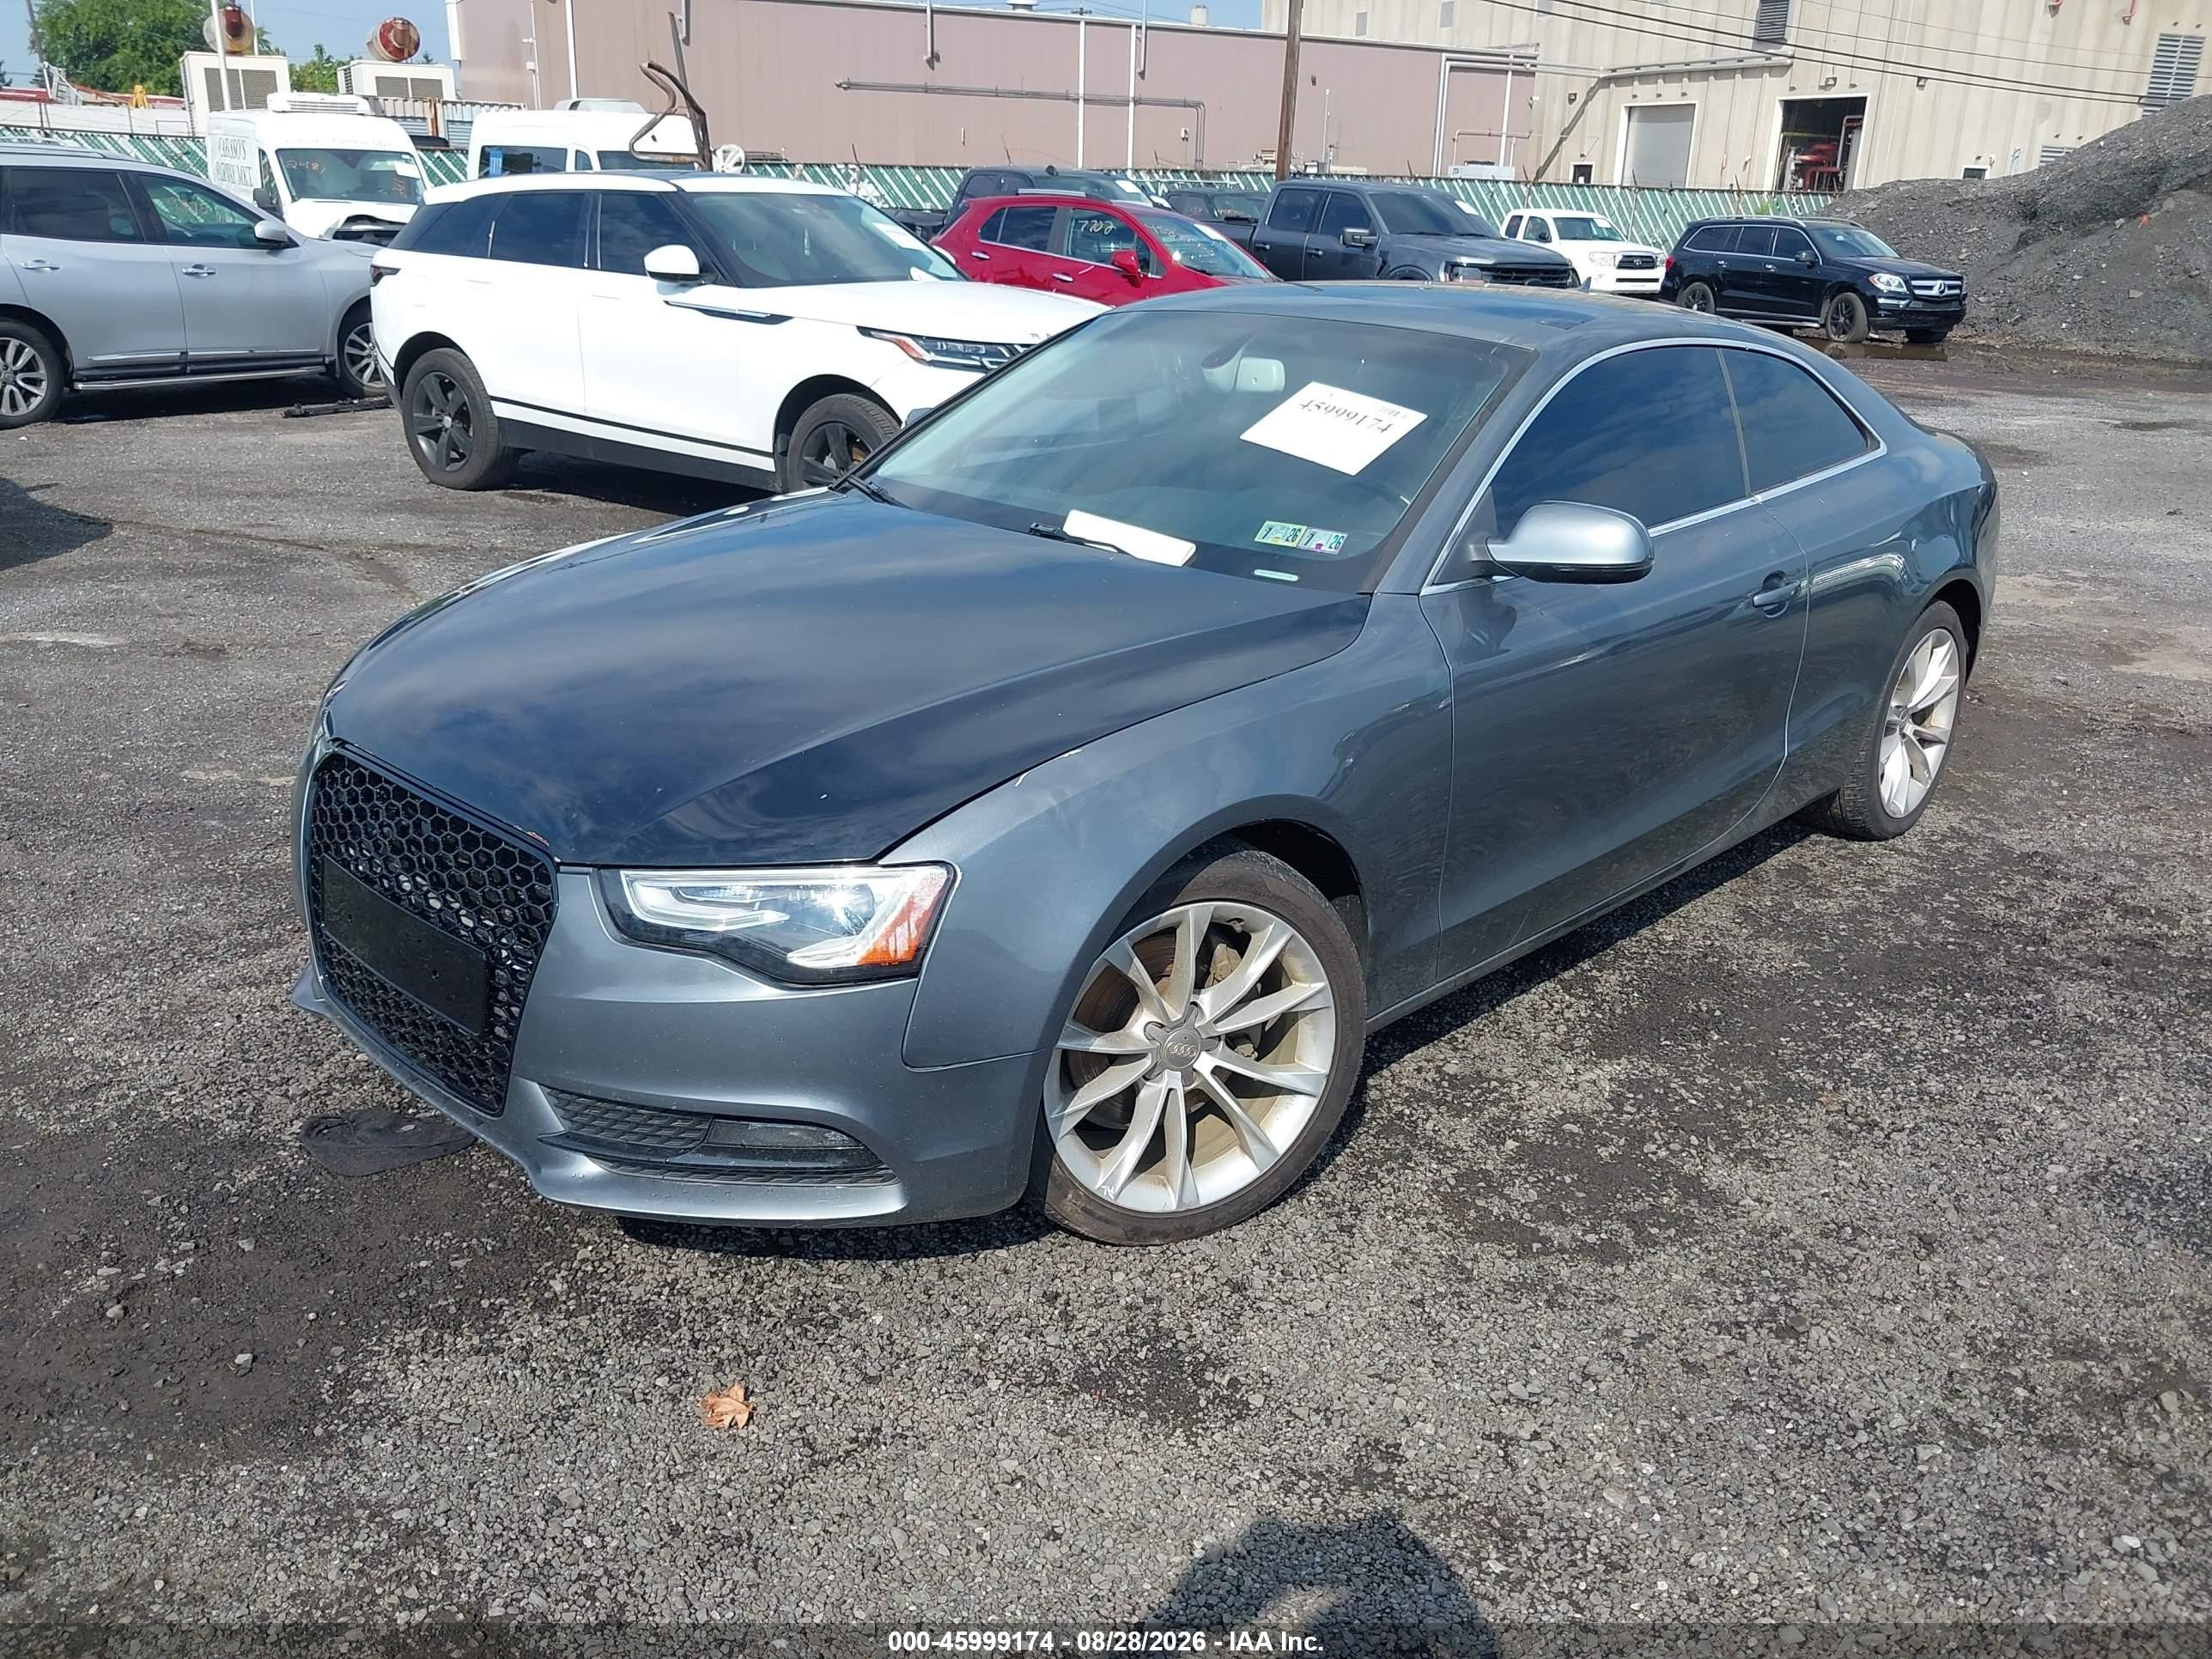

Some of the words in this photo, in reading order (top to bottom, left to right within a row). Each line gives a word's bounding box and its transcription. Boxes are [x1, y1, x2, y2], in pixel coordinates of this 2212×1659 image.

[1079, 220, 1116, 235] 7702
[1299, 399, 1394, 433] 45999174
[1285, 527, 1302, 543] 26
[1328, 534, 1345, 550] 26
